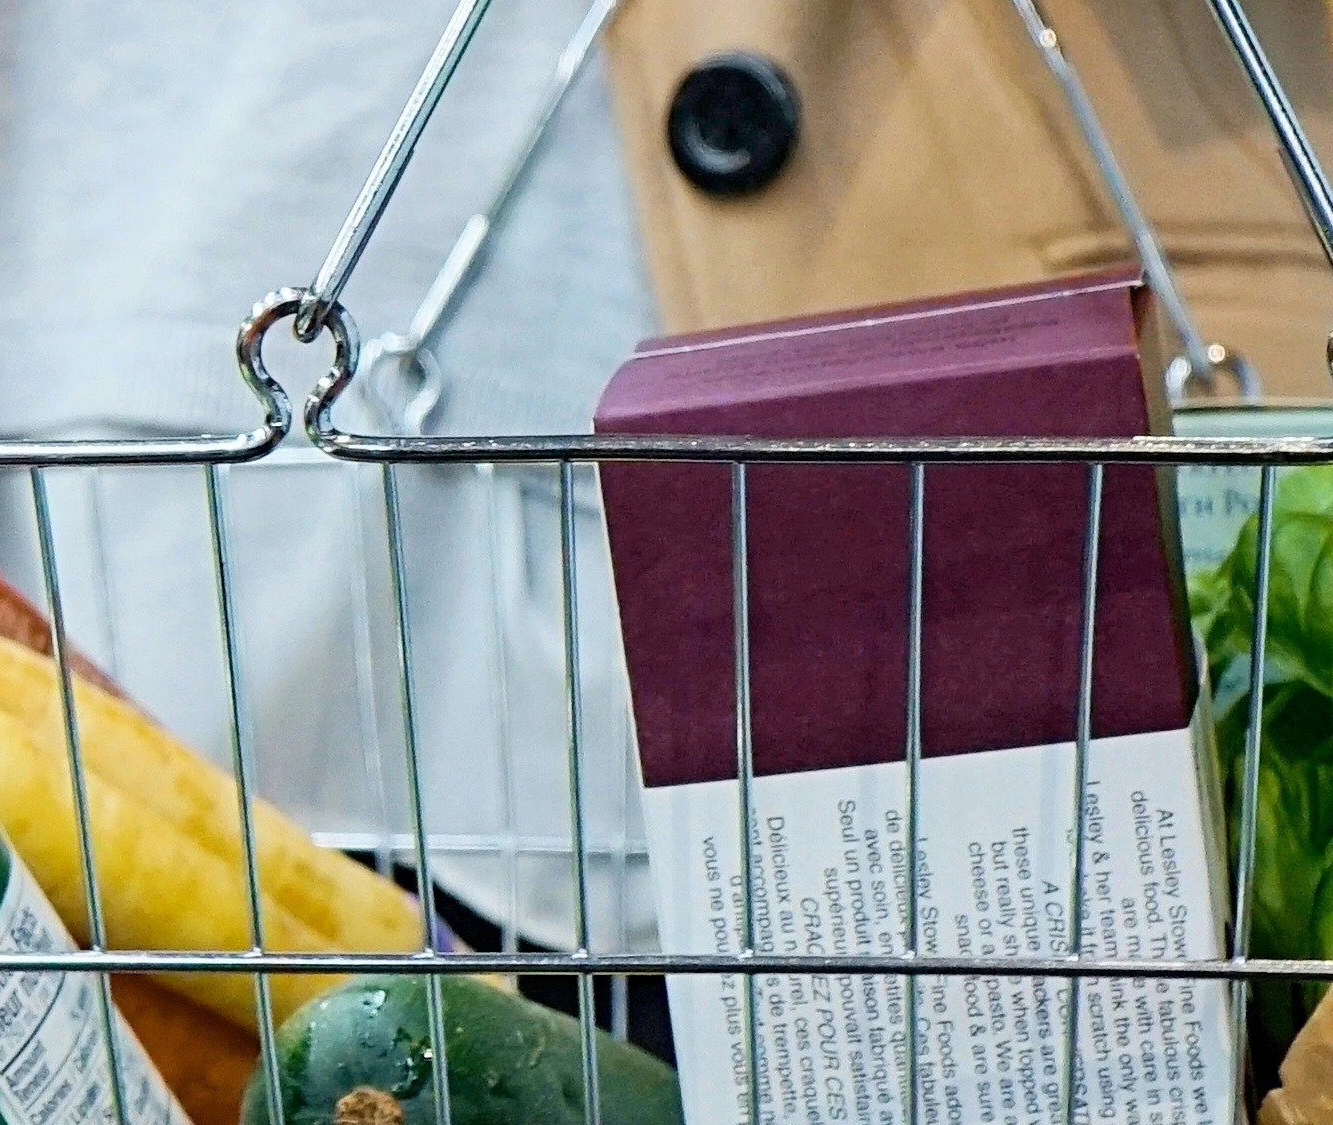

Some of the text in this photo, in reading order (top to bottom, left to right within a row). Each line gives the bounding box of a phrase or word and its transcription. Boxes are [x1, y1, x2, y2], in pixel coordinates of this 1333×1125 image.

[837, 799, 860, 843] Seul
[883, 809, 902, 834] de
[1129, 789, 1157, 876] delicious
[1157, 807, 1175, 828] At
[700, 835, 720, 881] vous
[766, 815, 796, 903] Délicieux
[844, 849, 860, 874] un
[863, 828, 883, 875] avec
[990, 840, 1010, 871] but
[1011, 826, 1035, 880] these
[1091, 849, 1109, 864] &
[1155, 834, 1183, 898] Lesley
[966, 840, 992, 912] cheese
[1042, 878, 1060, 894] A
[1094, 870, 1115, 905] her
[707, 886, 724, 912] ne
[843, 878, 873, 946] produit
[867, 879, 892, 925] soin,
[990, 876, 1017, 929] really
[1015, 886, 1042, 952] unique
[1119, 896, 1138, 929] are
[1142, 881, 1164, 928] food.
[779, 909, 796, 934] au
[877, 931, 893, 956] en
[977, 917, 992, 936] or
[1098, 907, 1121, 958] team
[1147, 932, 1174, 993] The
[717, 996, 743, 1035] plus
[768, 993, 787, 1017] de
[834, 975, 861, 1044] pouvait
[1030, 975, 1054, 1038] ackers
[1132, 995, 1155, 1035] with
[1177, 974, 1199, 1014] ine
[792, 1016, 811, 1051] ces
[969, 1022, 987, 1037] &
[1009, 991, 1032, 1042] when
[1086, 991, 1111, 1062] scratch
[1113, 1016, 1132, 1048] the
[814, 1007, 841, 1072] POUR
[935, 1020, 959, 1079] Foods
[971, 1043, 989, 1075] are
[993, 1039, 1015, 1073] We
[1039, 1043, 1057, 1076] are
[1139, 1039, 1159, 1083] care
[1156, 999, 1185, 1081] fabulous
[1182, 1020, 1208, 1081] Foods
[998, 1077, 1016, 1109] are
[1013, 1048, 1042, 1115] topped
[1092, 1066, 1119, 1118] using
[1113, 1052, 1138, 1093] only
[823, 1075, 848, 1121] CES
[976, 1080, 996, 1123] sure
[1145, 1087, 1163, 1106] in
